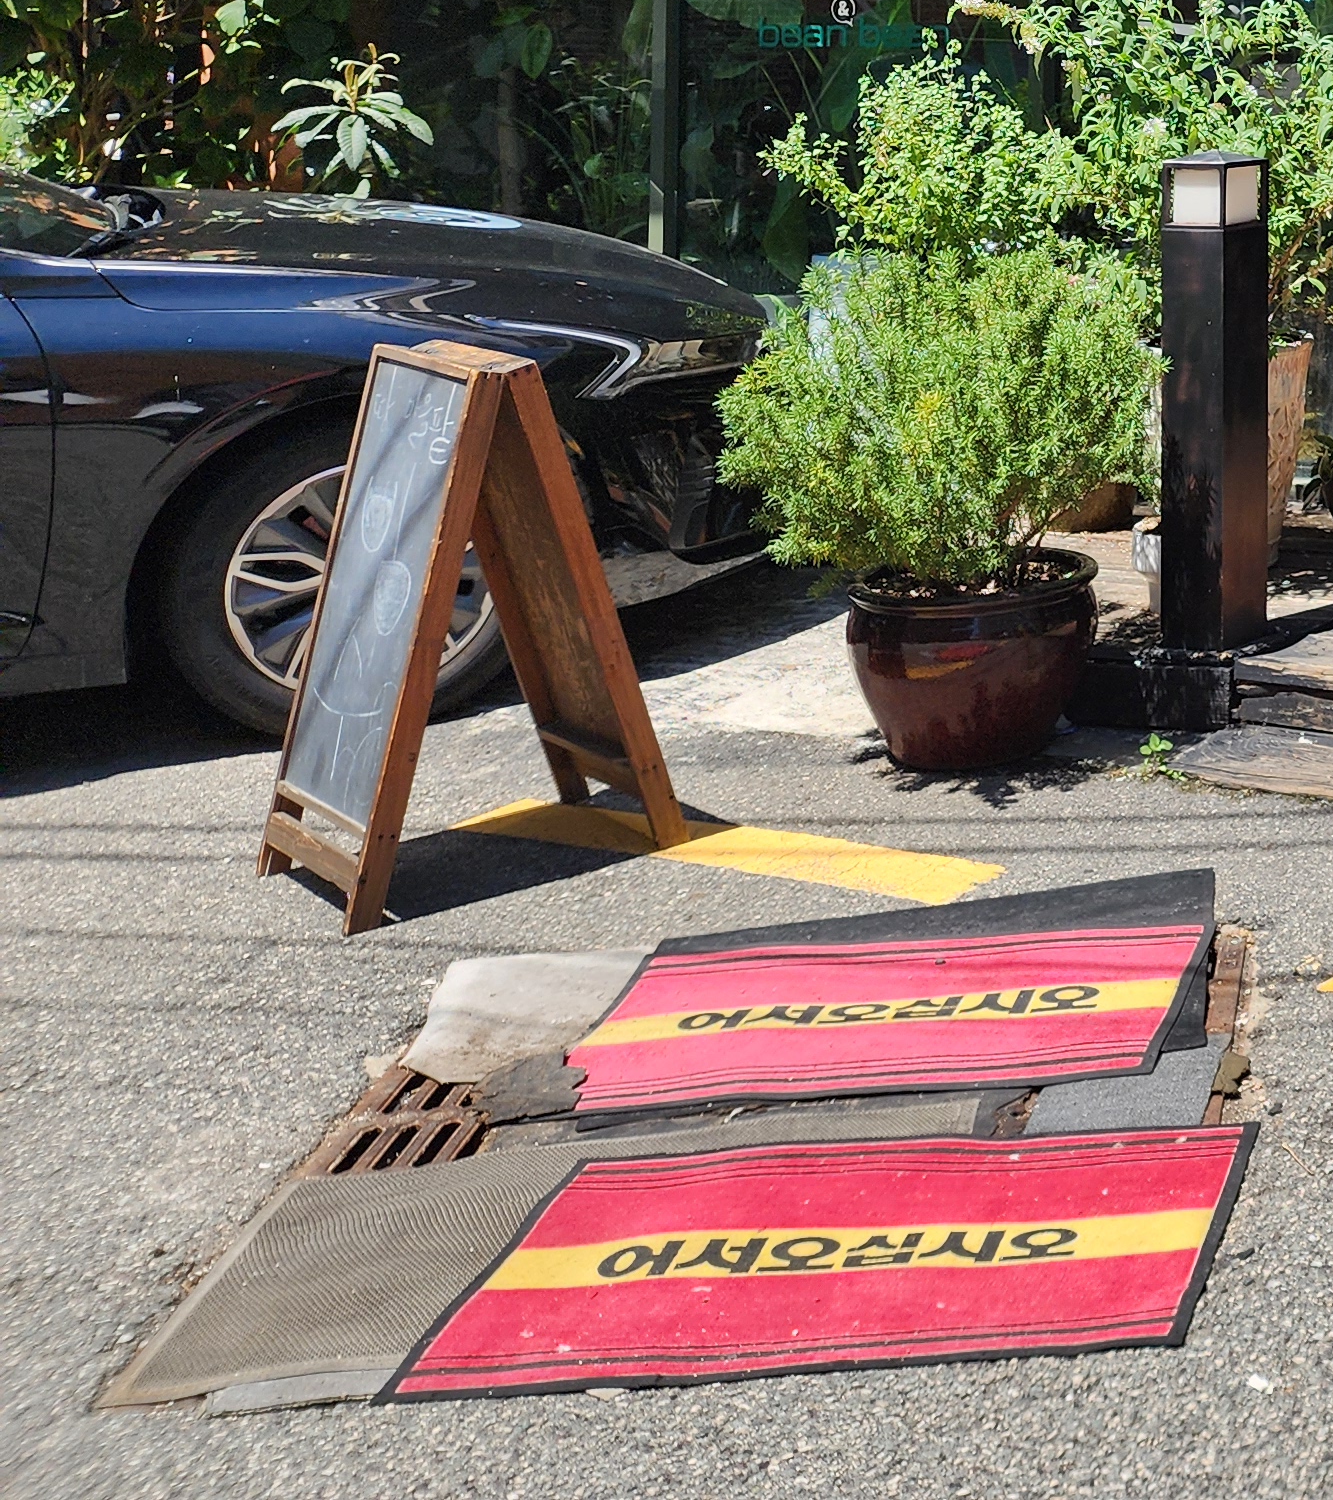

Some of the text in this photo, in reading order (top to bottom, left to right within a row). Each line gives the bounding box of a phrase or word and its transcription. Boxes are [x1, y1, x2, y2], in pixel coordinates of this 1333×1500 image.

[758, 16, 848, 48] bean
[677, 985, 1100, 1030] 어서오십시오
[597, 1228, 1078, 1278] 어서오십시오
